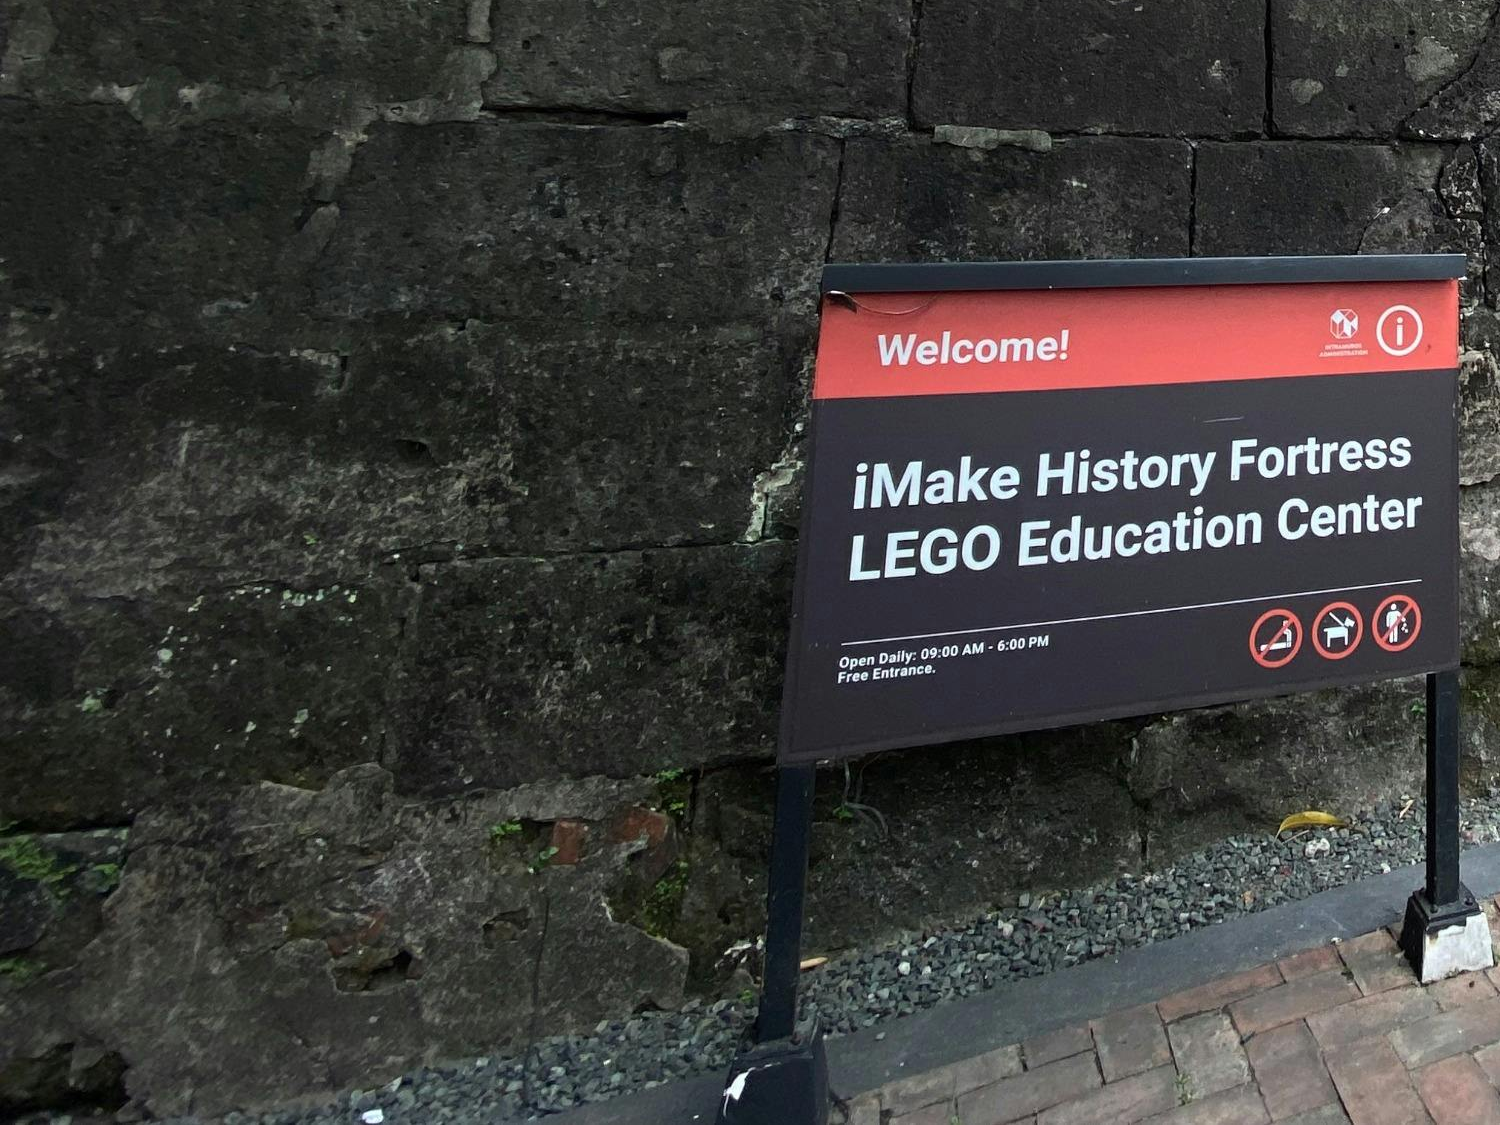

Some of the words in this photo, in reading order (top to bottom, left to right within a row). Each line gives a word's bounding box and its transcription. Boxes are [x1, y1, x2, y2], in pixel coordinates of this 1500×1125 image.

[877, 329, 1069, 367] Welcome!
[852, 455, 1021, 510] iMake
[1036, 448, 1217, 497] History
[1229, 434, 1413, 481] Fortress
[848, 524, 1001, 582] LEGO
[1017, 505, 1262, 567] Education
[1277, 492, 1423, 540] Center
[839, 655, 875, 670] Open
[878, 650, 917, 665] Daily:
[920, 645, 959, 660] 09:00
[961, 642, 985, 656] AM
[997, 637, 1026, 652] 6:00
[1028, 634, 1050, 648] PM
[837, 671, 868, 684] Free
[872, 664, 936, 680] Entrance.
